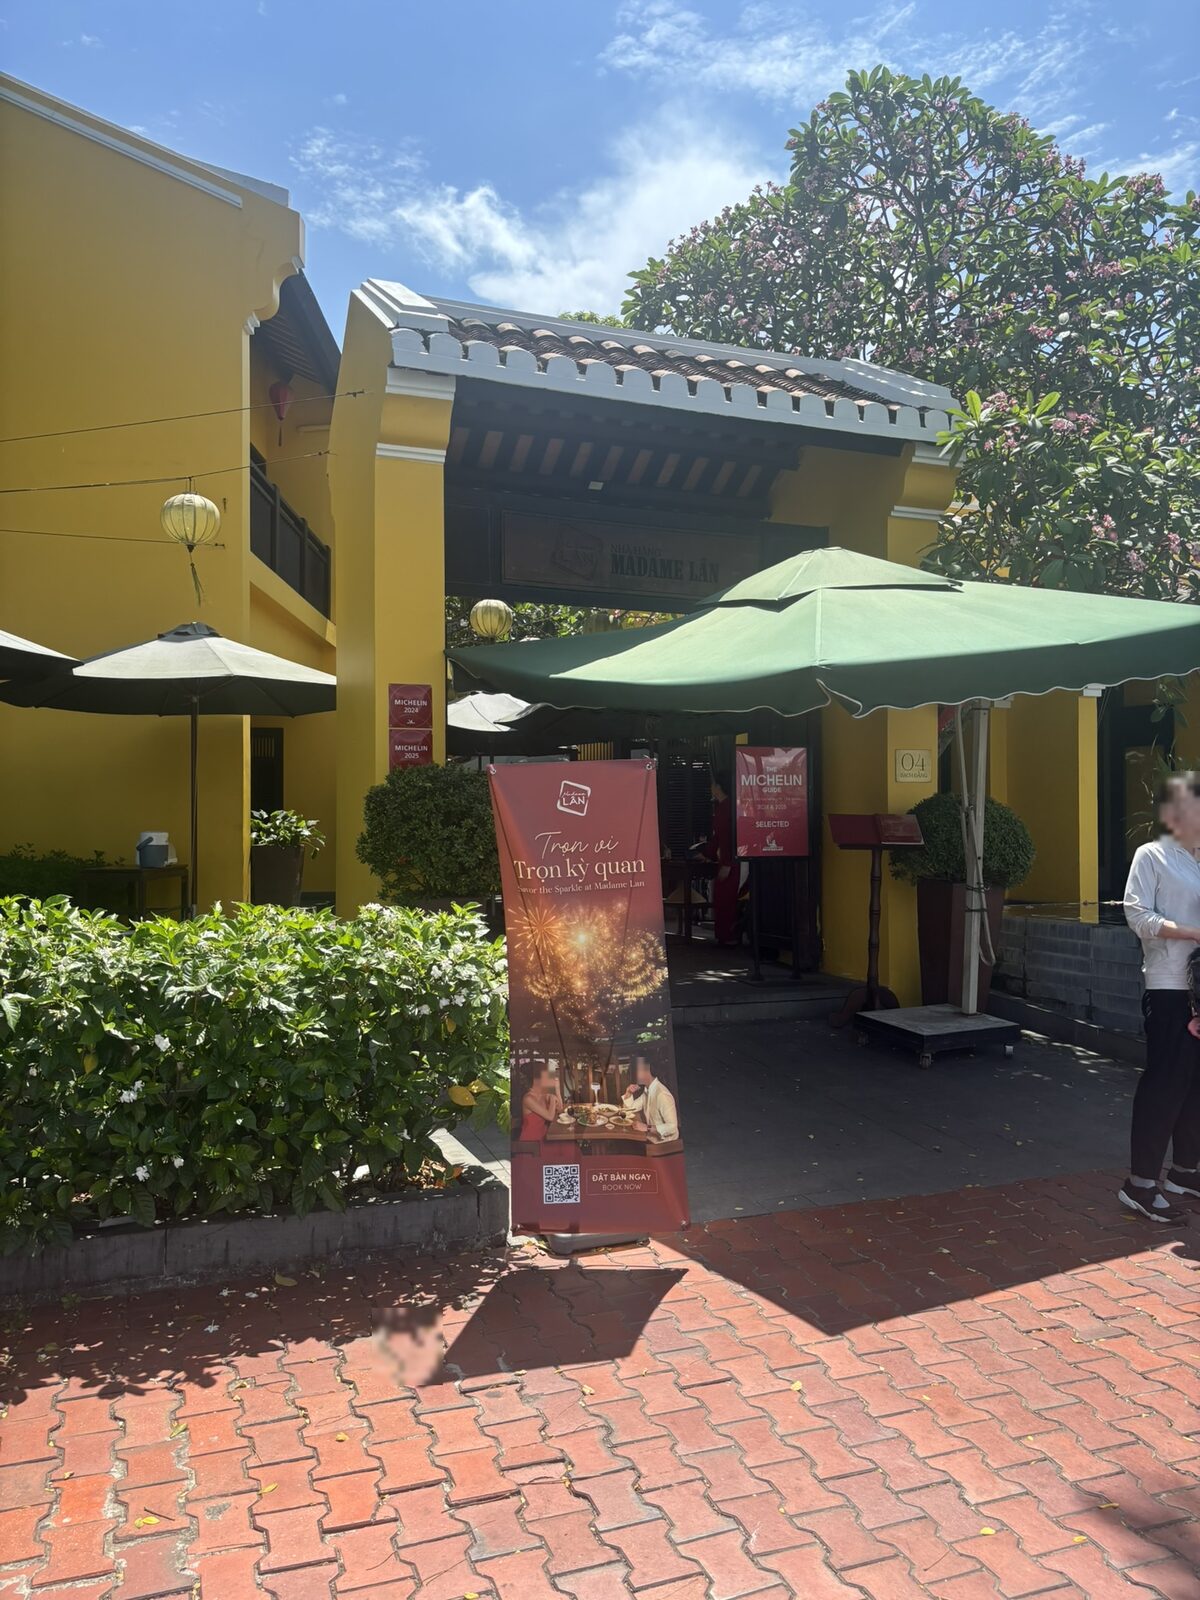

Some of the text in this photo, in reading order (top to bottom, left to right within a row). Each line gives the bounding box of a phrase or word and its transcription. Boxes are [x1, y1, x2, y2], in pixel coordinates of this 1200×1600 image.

[610, 553, 720, 583] MADAME LÂN
[901, 752, 925, 771] 04
[741, 774, 802, 786] MICHELIN
[563, 795, 585, 806] LÂN
[755, 820, 790, 828] SELECTED
[535, 831, 619, 860] Trọn vị
[513, 857, 646, 883] Trọn kỳ quan
[539, 885, 553, 894] the
[555, 883, 582, 895] Sparkle
[594, 882, 627, 890] Madame
[629, 880, 645, 888] Lan
[610, 1171, 627, 1181] BÀN
[629, 1173, 651, 1181] NGAY
